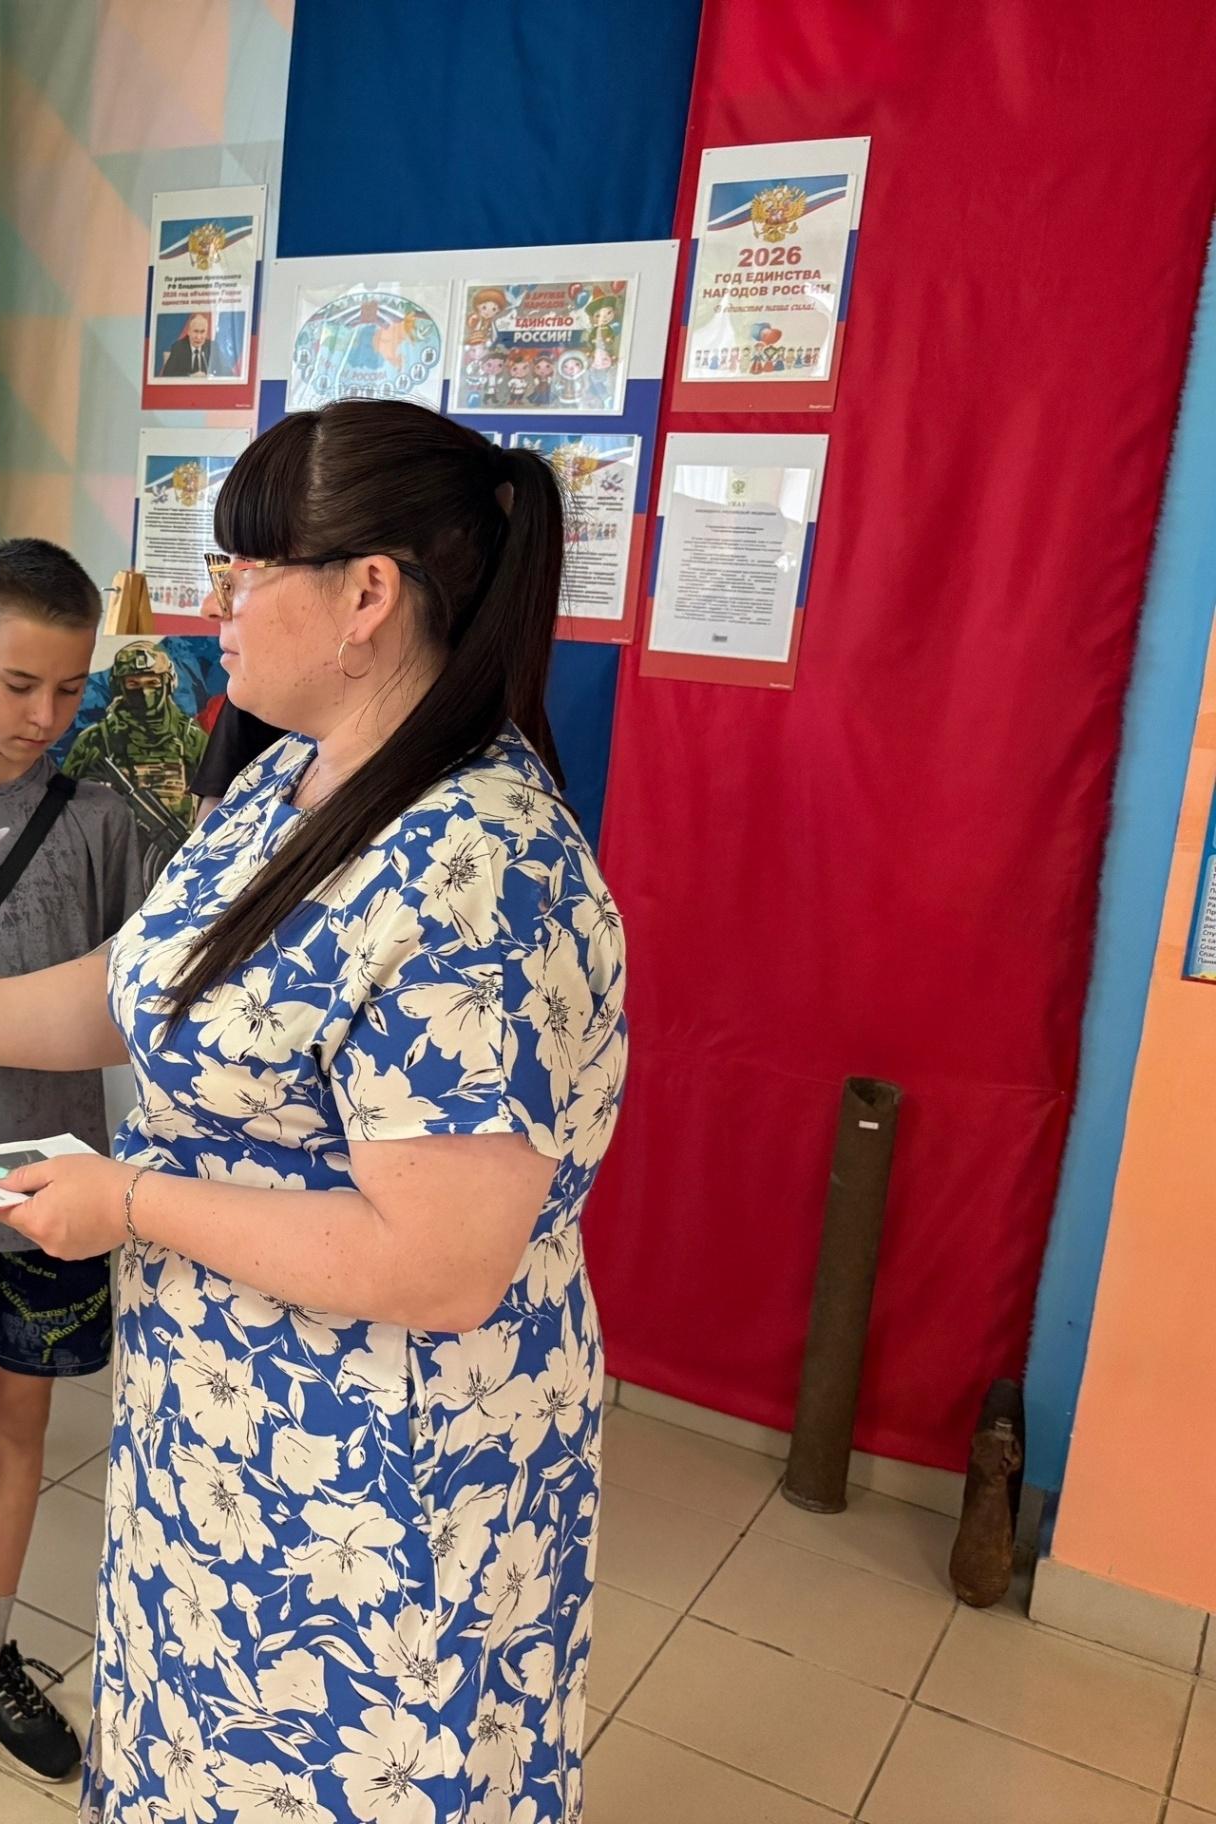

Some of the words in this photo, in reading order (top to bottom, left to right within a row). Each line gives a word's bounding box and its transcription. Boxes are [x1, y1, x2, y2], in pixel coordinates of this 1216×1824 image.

[737, 246, 802, 267] 2026
[714, 273, 742, 284] ГОД
[745, 269, 821, 283] ЕДИНСТВА
[702, 285, 768, 299] НАРОДОВ
[772, 283, 831, 296] РОССИ
[515, 316, 574, 329] ЕДИНСТВО
[513, 331, 573, 343] РОССИИ!
